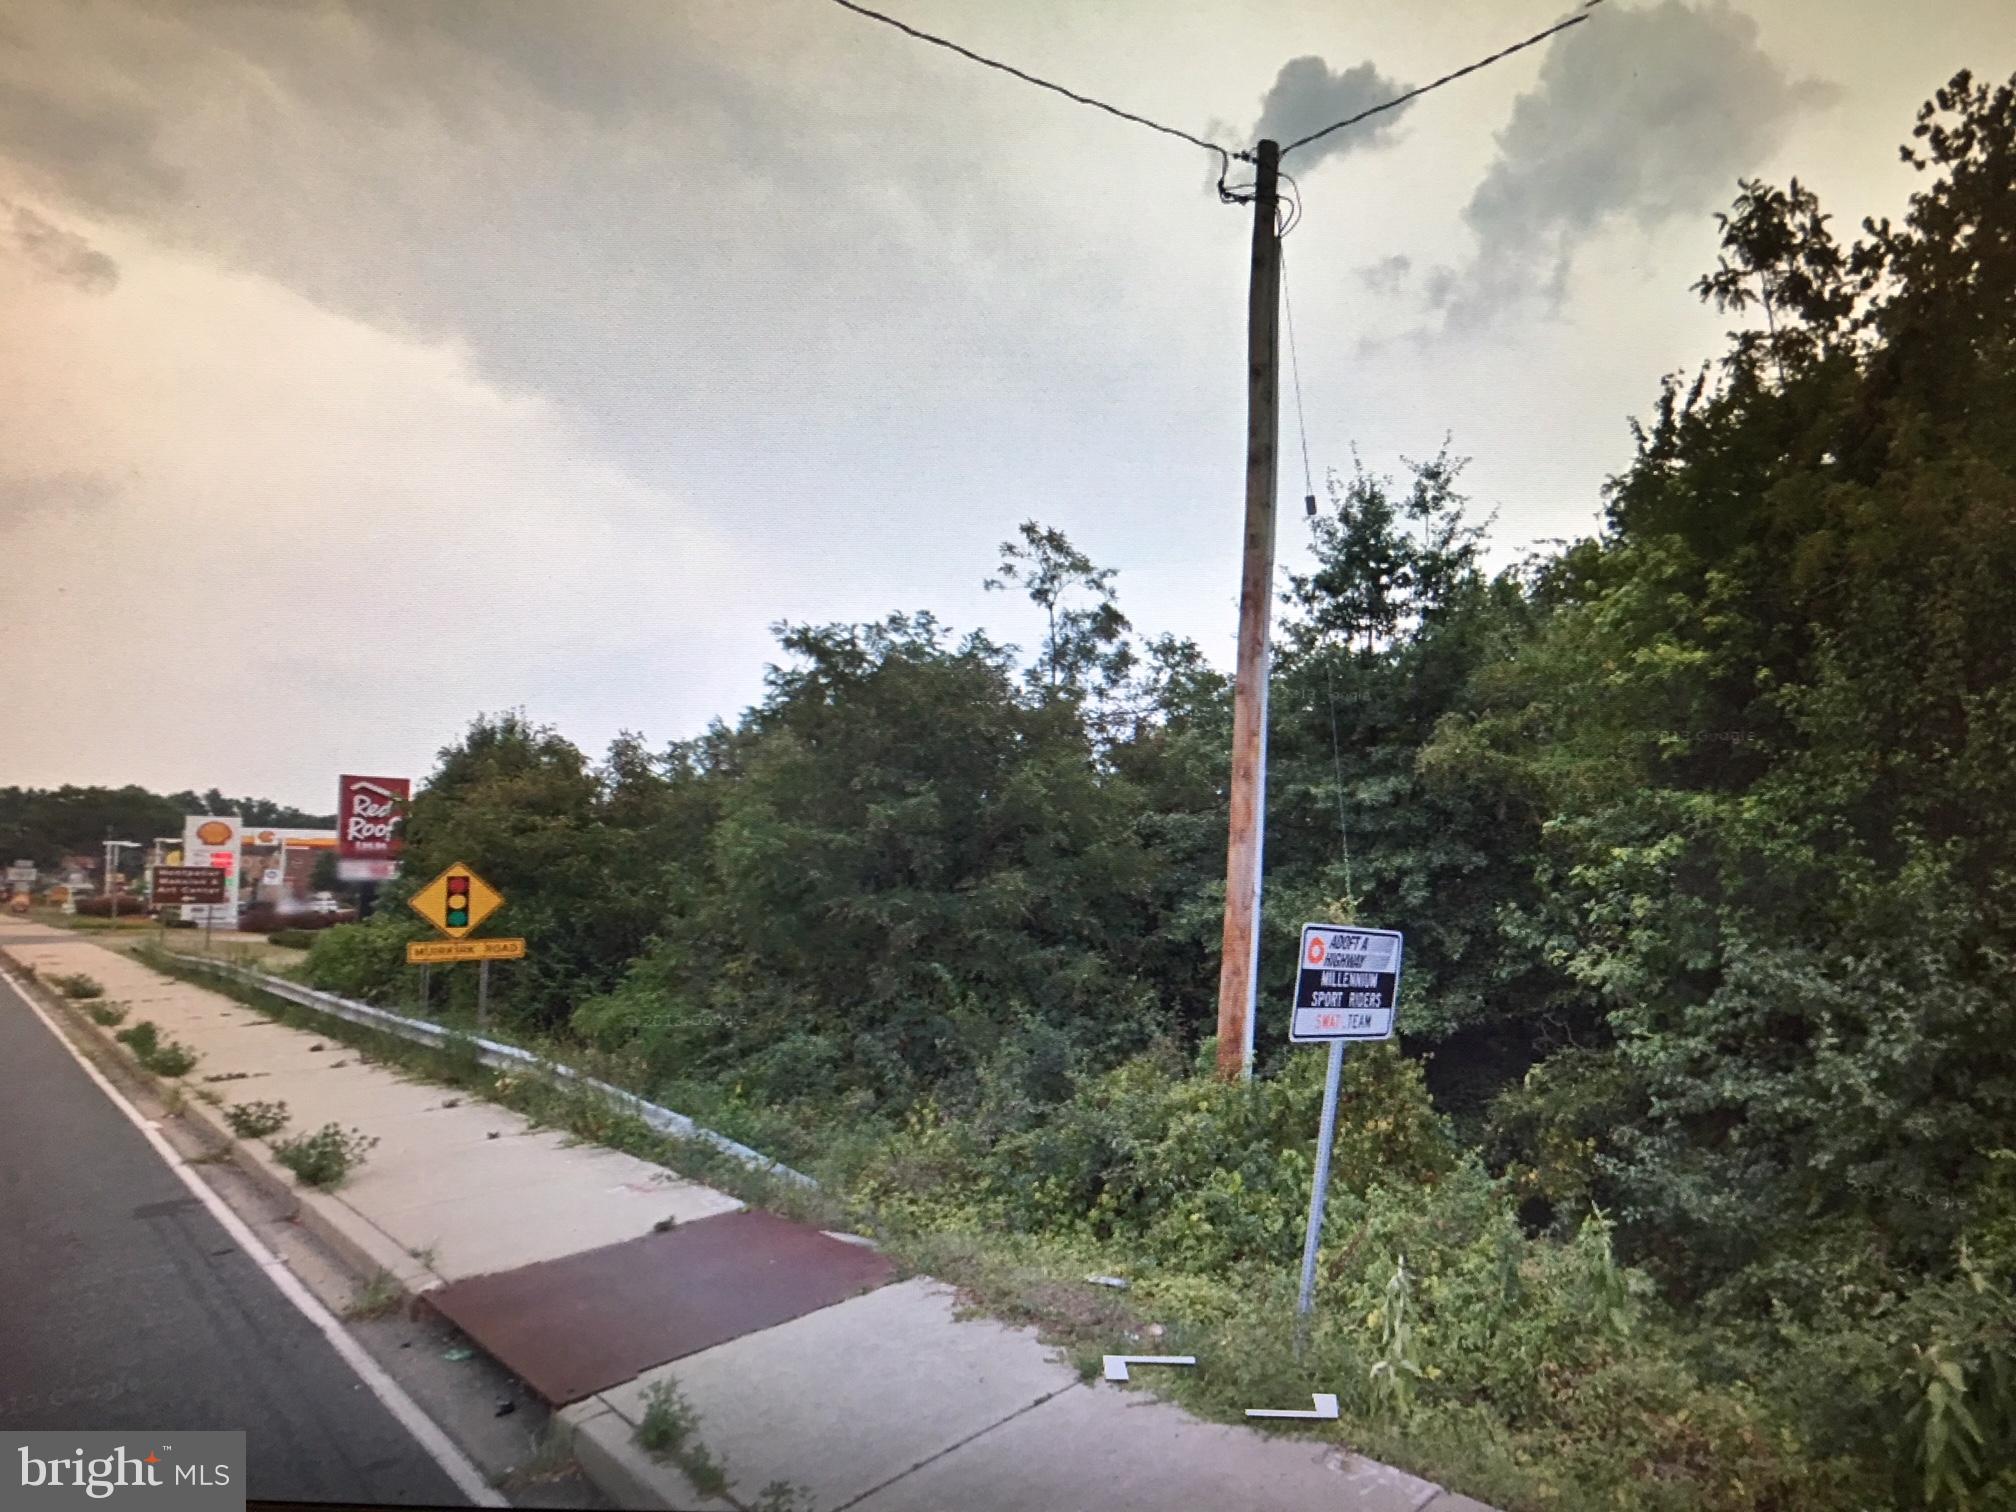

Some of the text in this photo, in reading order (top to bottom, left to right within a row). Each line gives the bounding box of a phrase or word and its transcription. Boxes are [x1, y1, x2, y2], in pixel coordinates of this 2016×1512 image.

[352, 794, 394, 817] Red
[347, 813, 402, 842] Roof
[1330, 935, 1369, 951] ADOPT A
[1324, 953, 1366, 968] HIGHWAY
[1311, 991, 1343, 1006] SPORT
[1348, 992, 1382, 1008] RIDERS
[1347, 1014, 1372, 1028] TEAM
